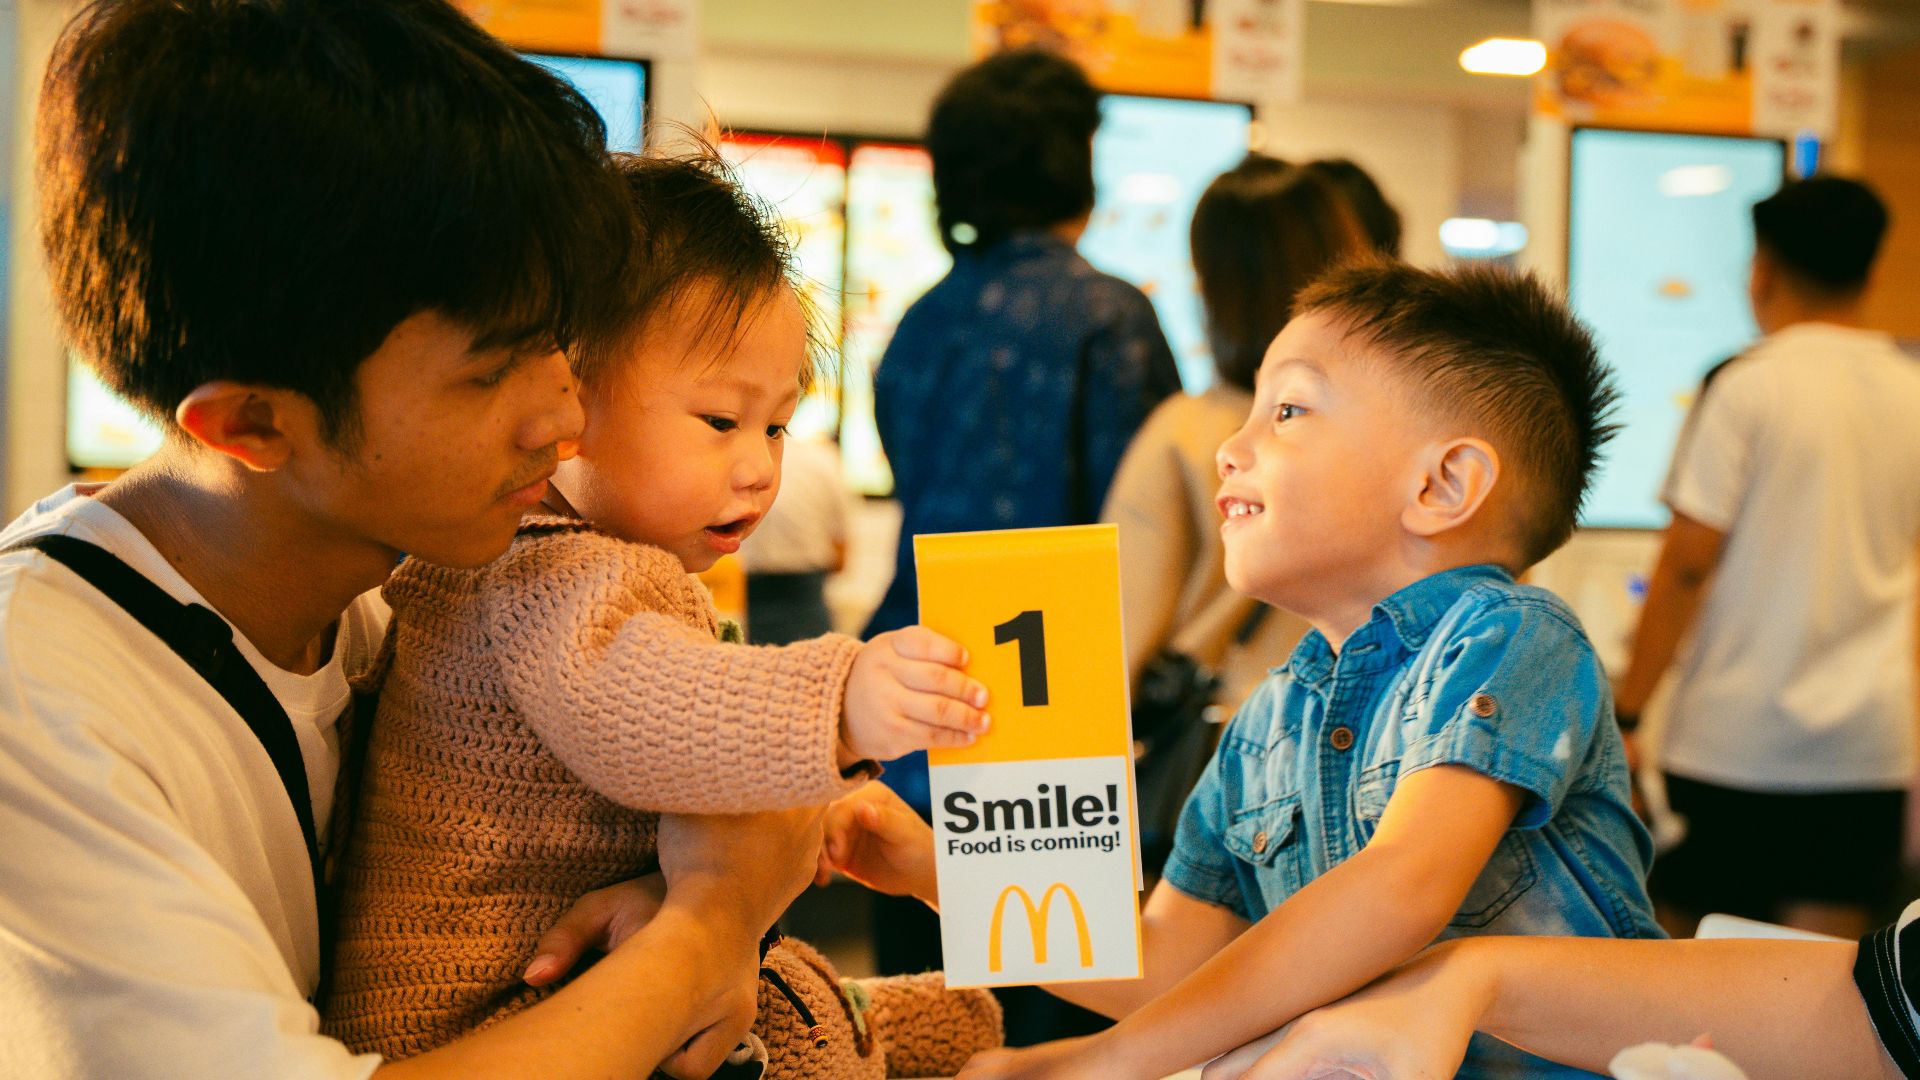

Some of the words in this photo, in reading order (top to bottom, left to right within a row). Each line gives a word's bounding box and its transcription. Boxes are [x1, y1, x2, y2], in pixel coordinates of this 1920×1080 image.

[994, 610, 1049, 706] 1
[944, 784, 1119, 833] Smile!
[948, 836, 1001, 855] Food
[1007, 835, 1025, 852] is
[1031, 832, 1120, 853] coming!
